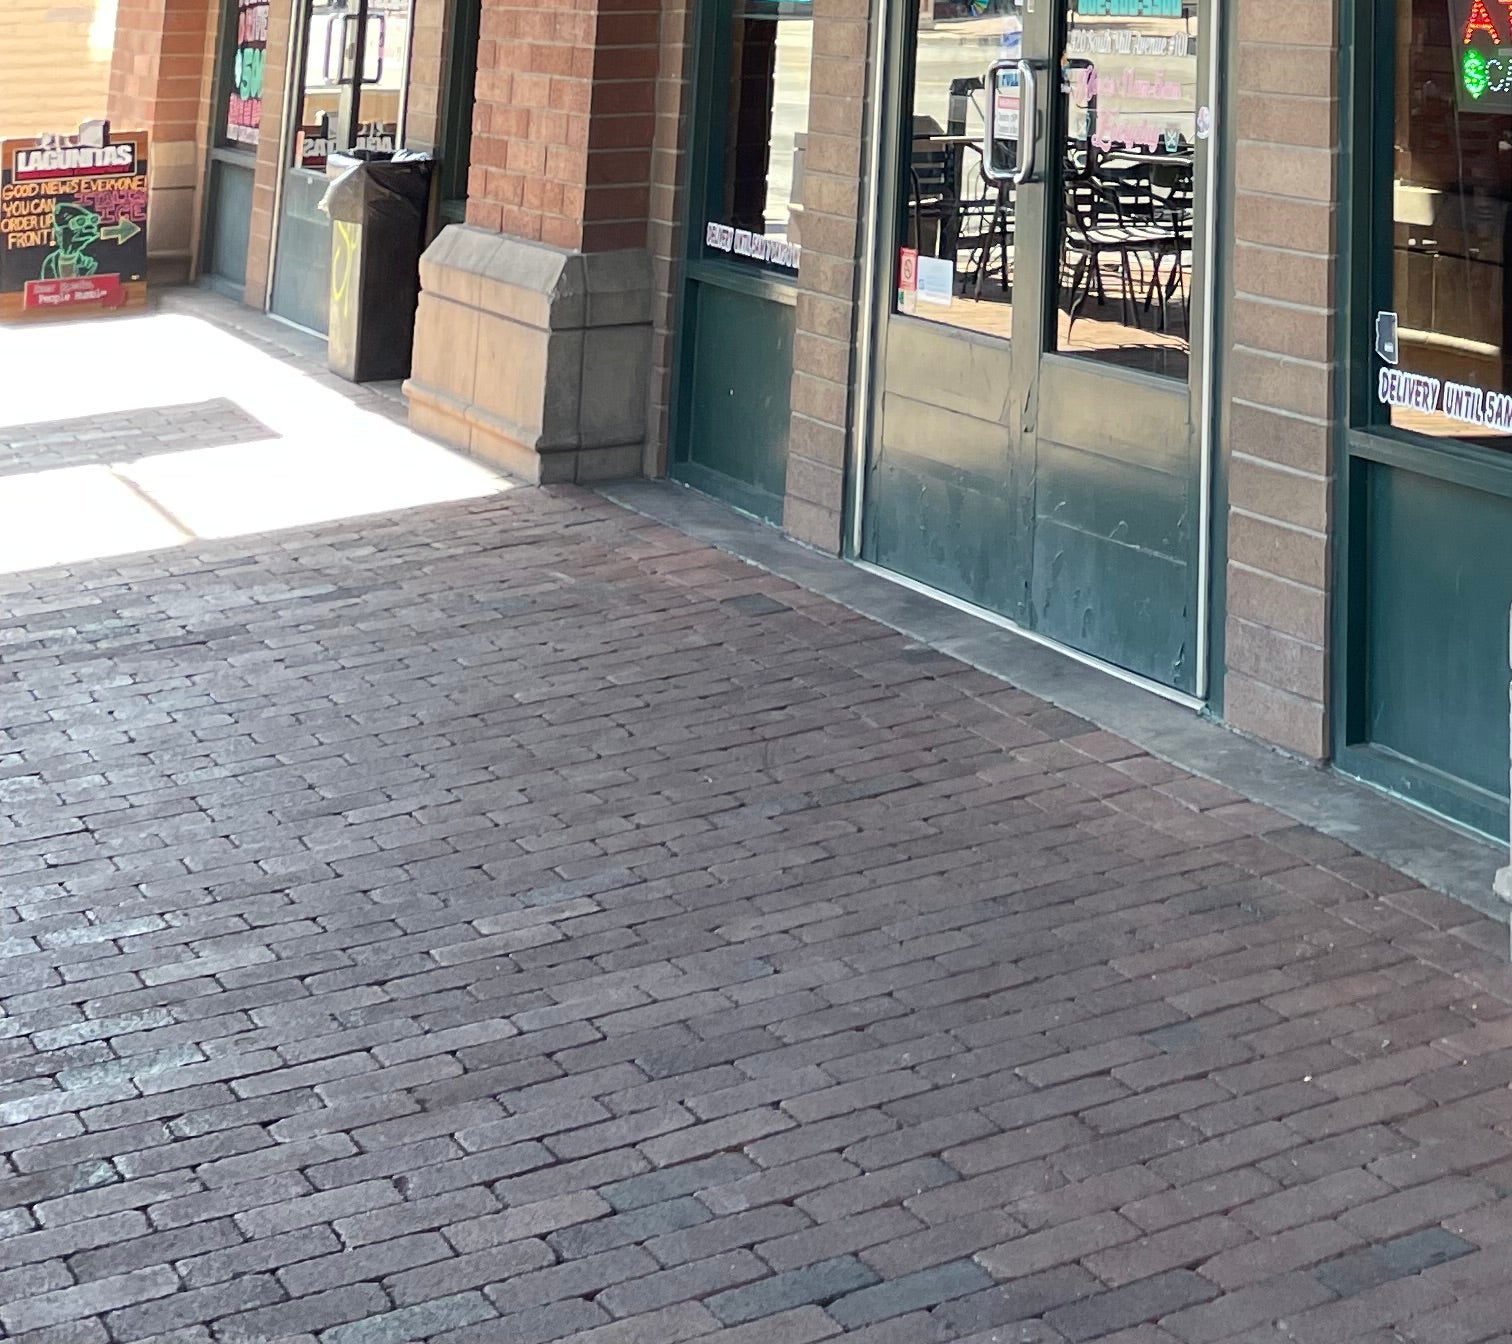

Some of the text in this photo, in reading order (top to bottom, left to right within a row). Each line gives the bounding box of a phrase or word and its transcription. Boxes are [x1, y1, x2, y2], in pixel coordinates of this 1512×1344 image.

[16, 145, 133, 173] LAGUNITAS
[2, 175, 147, 200] GOOD NEWS EVERYONE!
[2, 200, 30, 217] YOU
[30, 198, 57, 214] CAN
[1, 215, 56, 233] ORDER UP
[8, 229, 57, 250] FRONT!
[1379, 367, 1439, 415] DELIVERY
[1444, 381, 1483, 425] UNTIL
